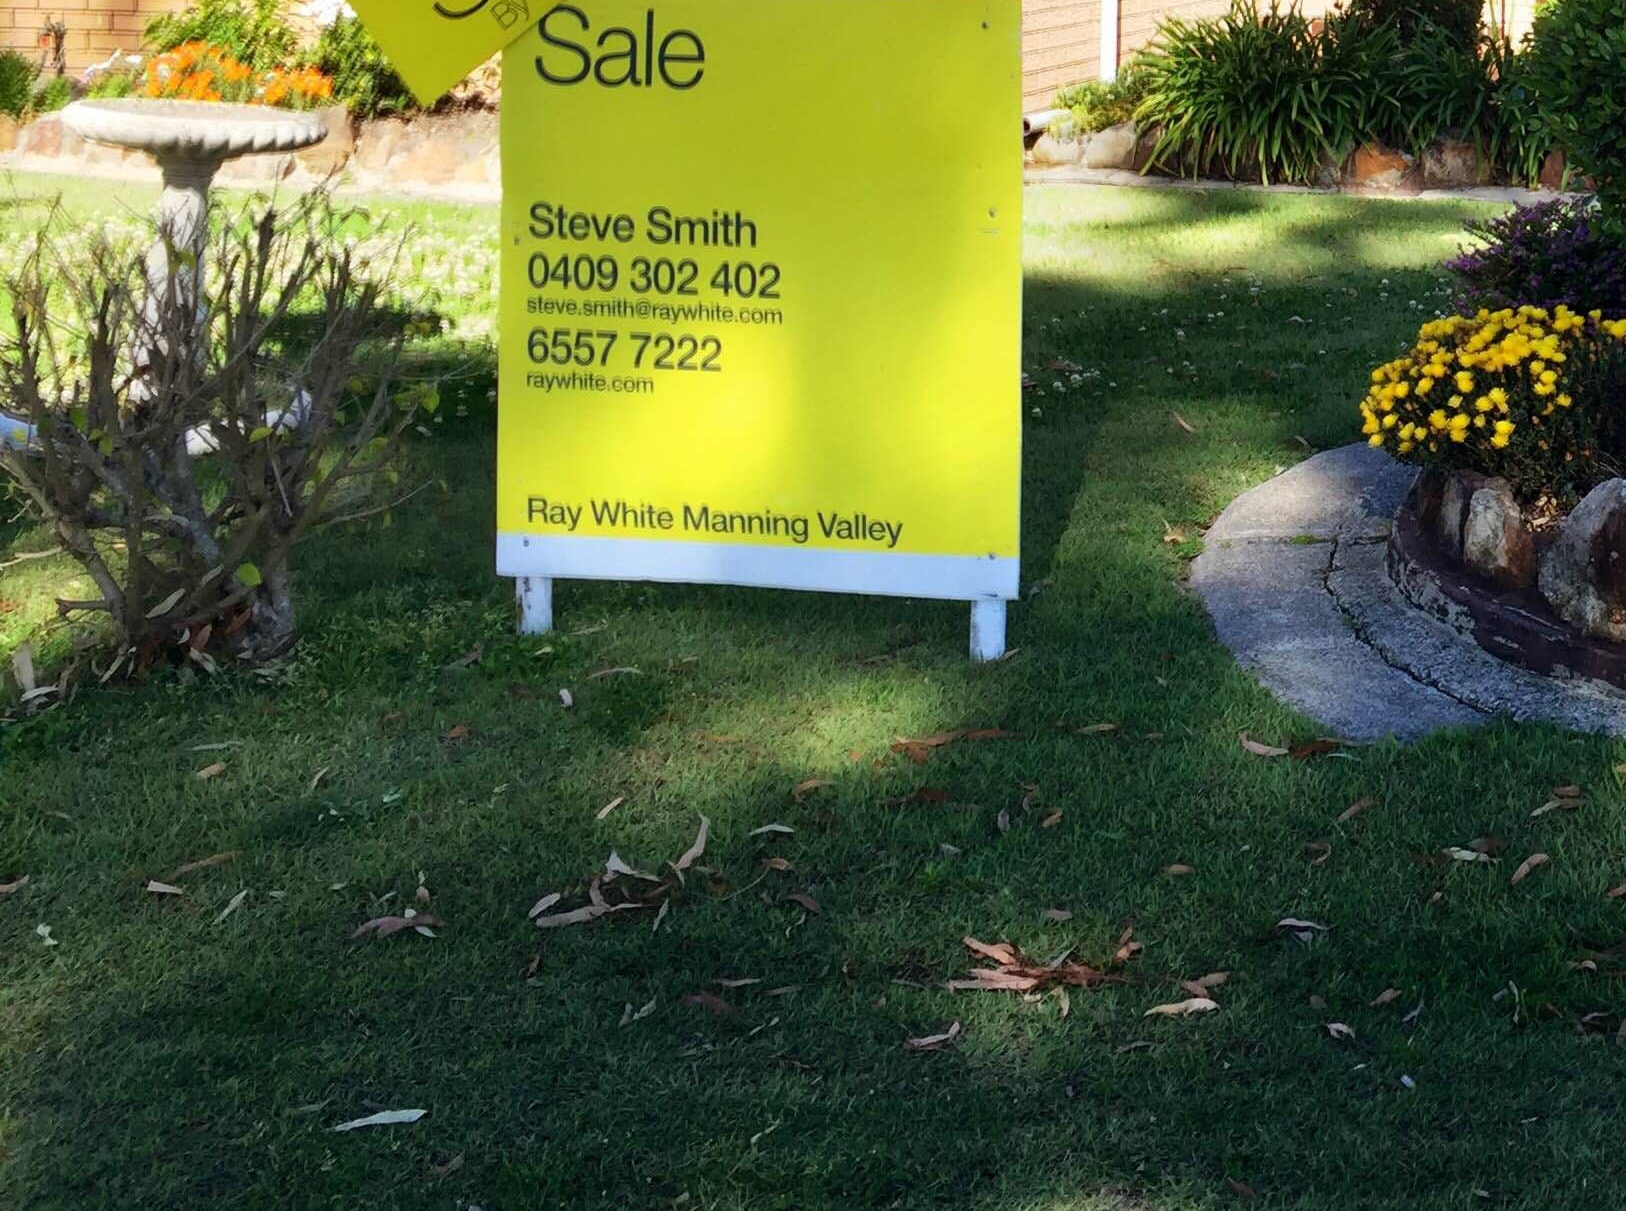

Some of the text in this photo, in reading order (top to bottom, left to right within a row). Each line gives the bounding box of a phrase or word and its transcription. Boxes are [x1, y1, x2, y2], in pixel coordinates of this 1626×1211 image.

[534, 3, 706, 91] Sale
[528, 200, 757, 248] Steve Smith
[527, 252, 781, 300] 0409 302 402
[527, 296, 783, 325] steve.smith@raywhite.com
[527, 326, 723, 372] 6557 7222
[526, 371, 654, 394] raywhite.com
[527, 496, 903, 549] Ray White Manning Valley
